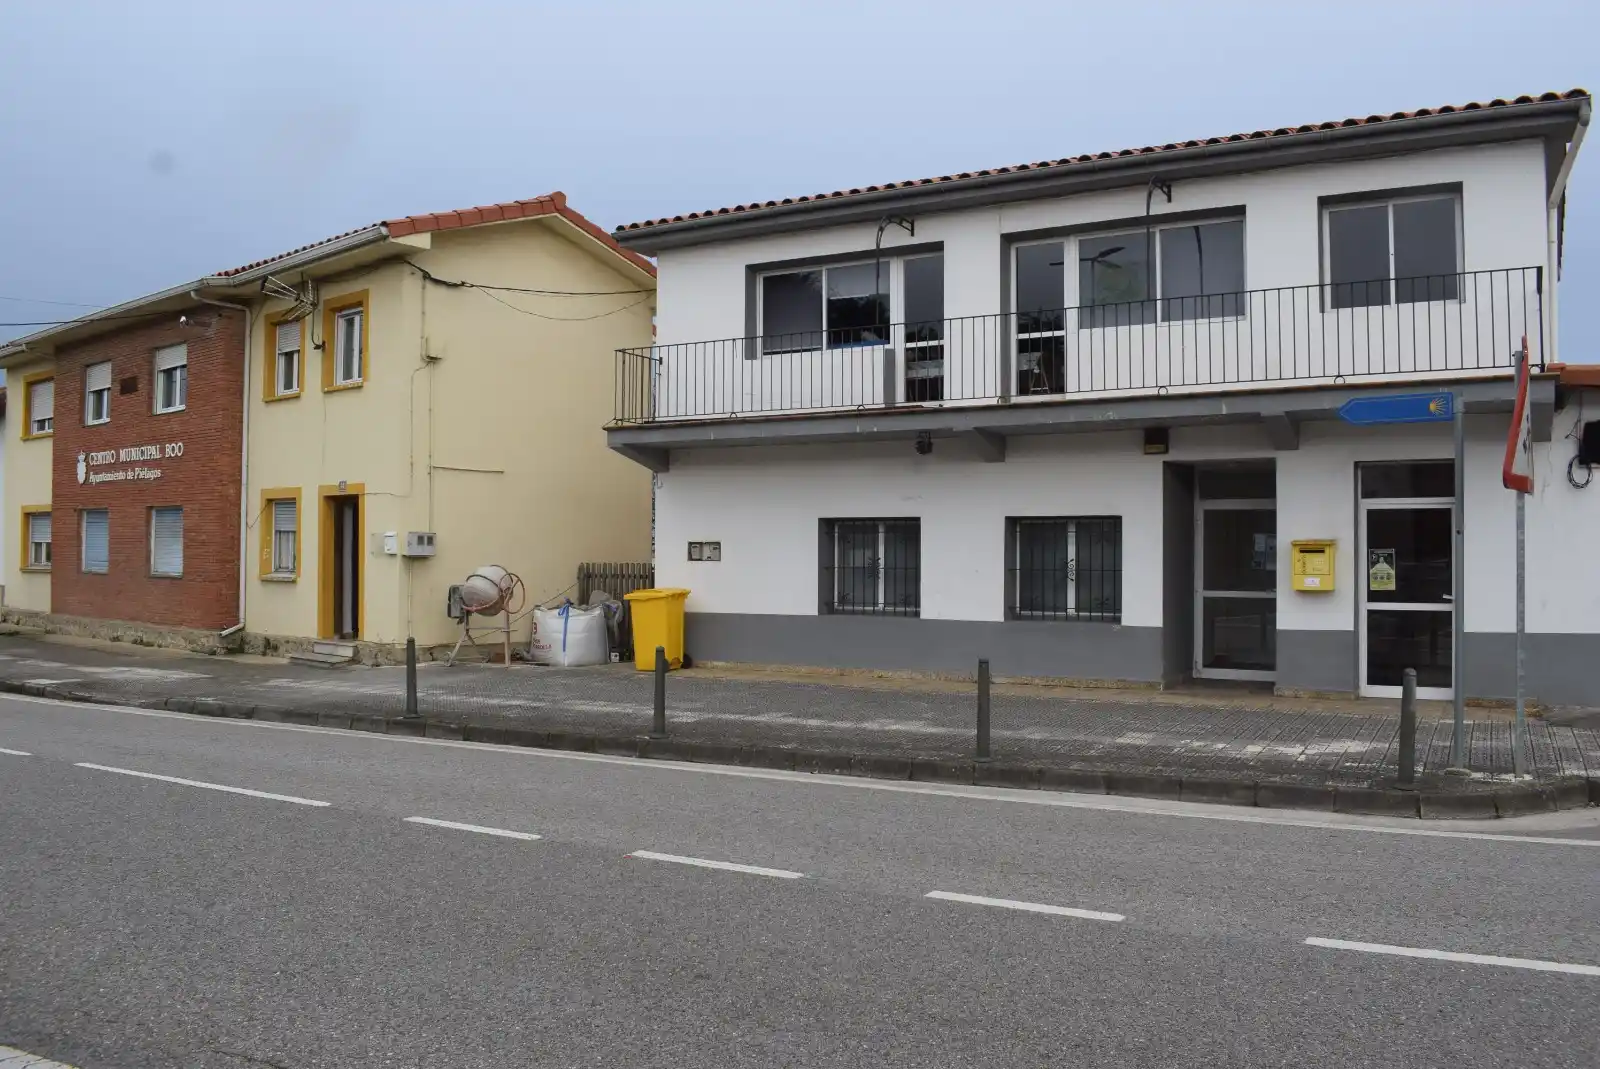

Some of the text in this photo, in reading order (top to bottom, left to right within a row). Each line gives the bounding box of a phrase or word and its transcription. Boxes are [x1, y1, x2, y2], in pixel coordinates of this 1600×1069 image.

[89, 442, 183, 465] CENTRO MUNICIPAL BOO
[89, 471, 126, 485] Ayuntamiento
[127, 468, 134, 480] de
